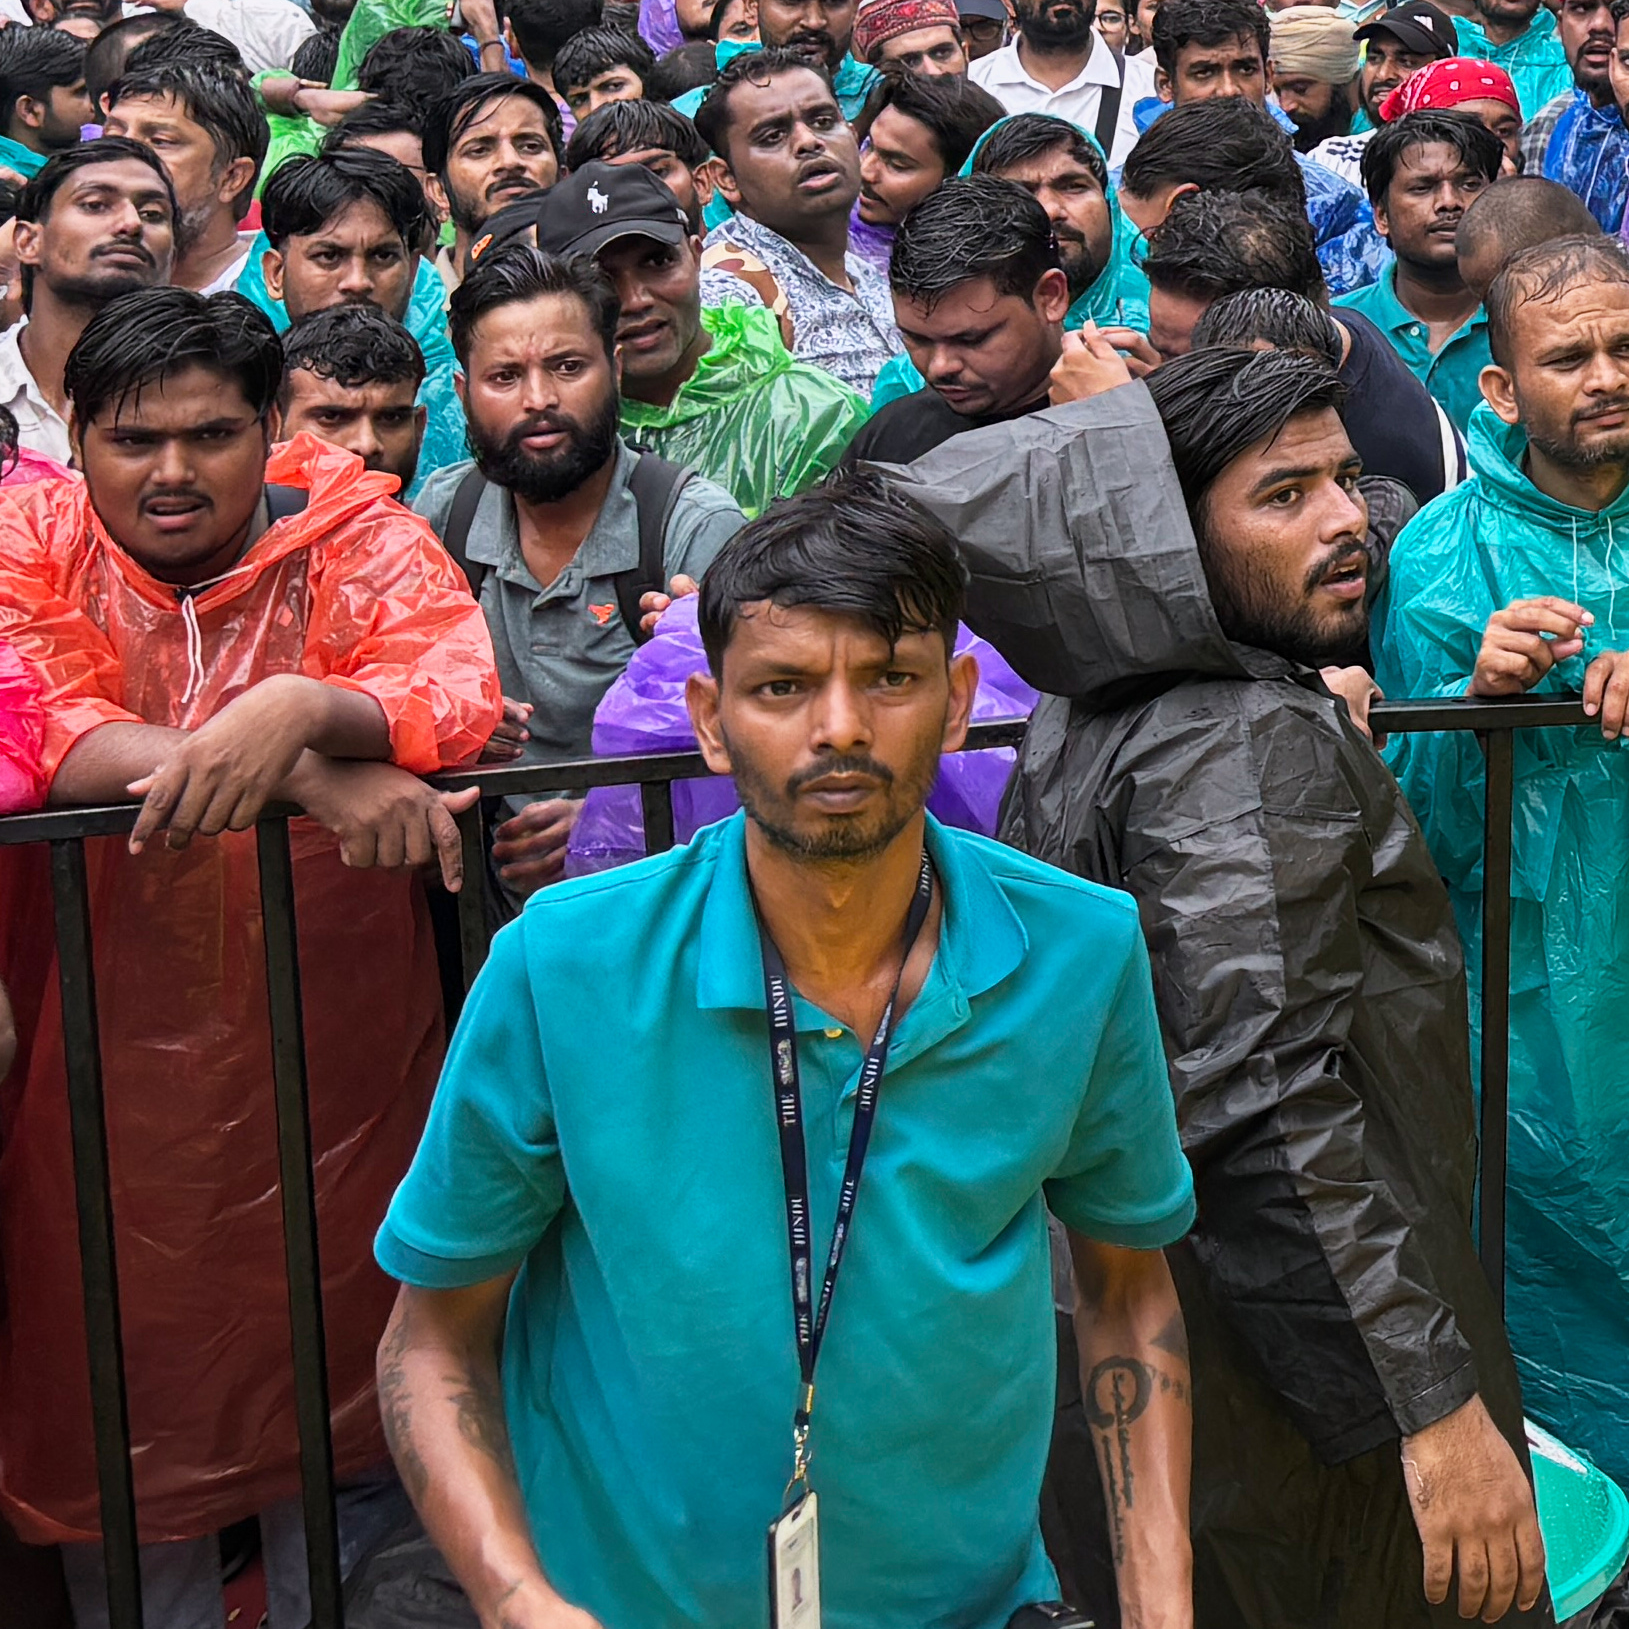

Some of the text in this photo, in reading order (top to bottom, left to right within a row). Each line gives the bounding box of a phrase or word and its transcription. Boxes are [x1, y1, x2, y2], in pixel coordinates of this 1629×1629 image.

[769, 975, 797, 1128] THE HINDU
[860, 1058, 880, 1111] HINDU
